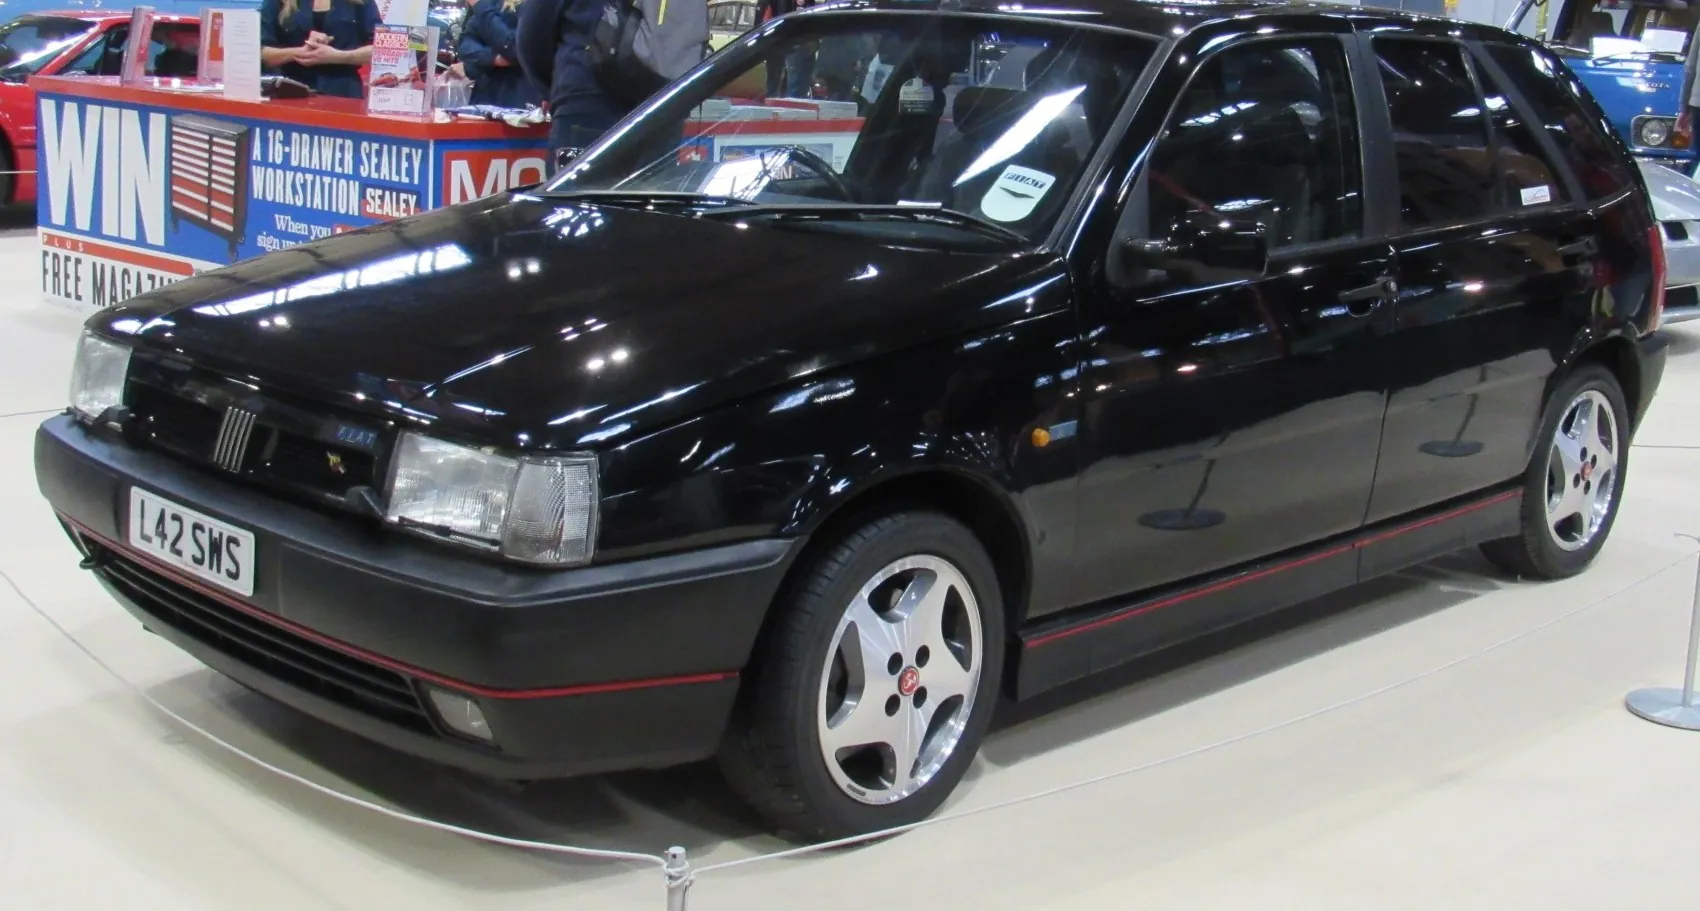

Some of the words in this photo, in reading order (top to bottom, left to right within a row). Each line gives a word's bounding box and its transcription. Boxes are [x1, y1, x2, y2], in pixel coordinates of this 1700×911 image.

[252, 127, 262, 161] A
[267, 129, 354, 175] 16-DRAWER
[360, 141, 423, 185] SEALEY
[40, 98, 167, 247] WIN
[1004, 173, 1046, 189] FIAT
[252, 165, 360, 216] WORKSTATION
[366, 188, 417, 217] SEALEY
[274, 214, 309, 235] When
[310, 225, 332, 239] you
[43, 235, 84, 251] PLUS
[257, 232, 280, 251] sign
[42, 250, 83, 301] FREE
[338, 425, 376, 447] FIAT
[140, 499, 184, 557] L42
[191, 522, 241, 581] SWS
